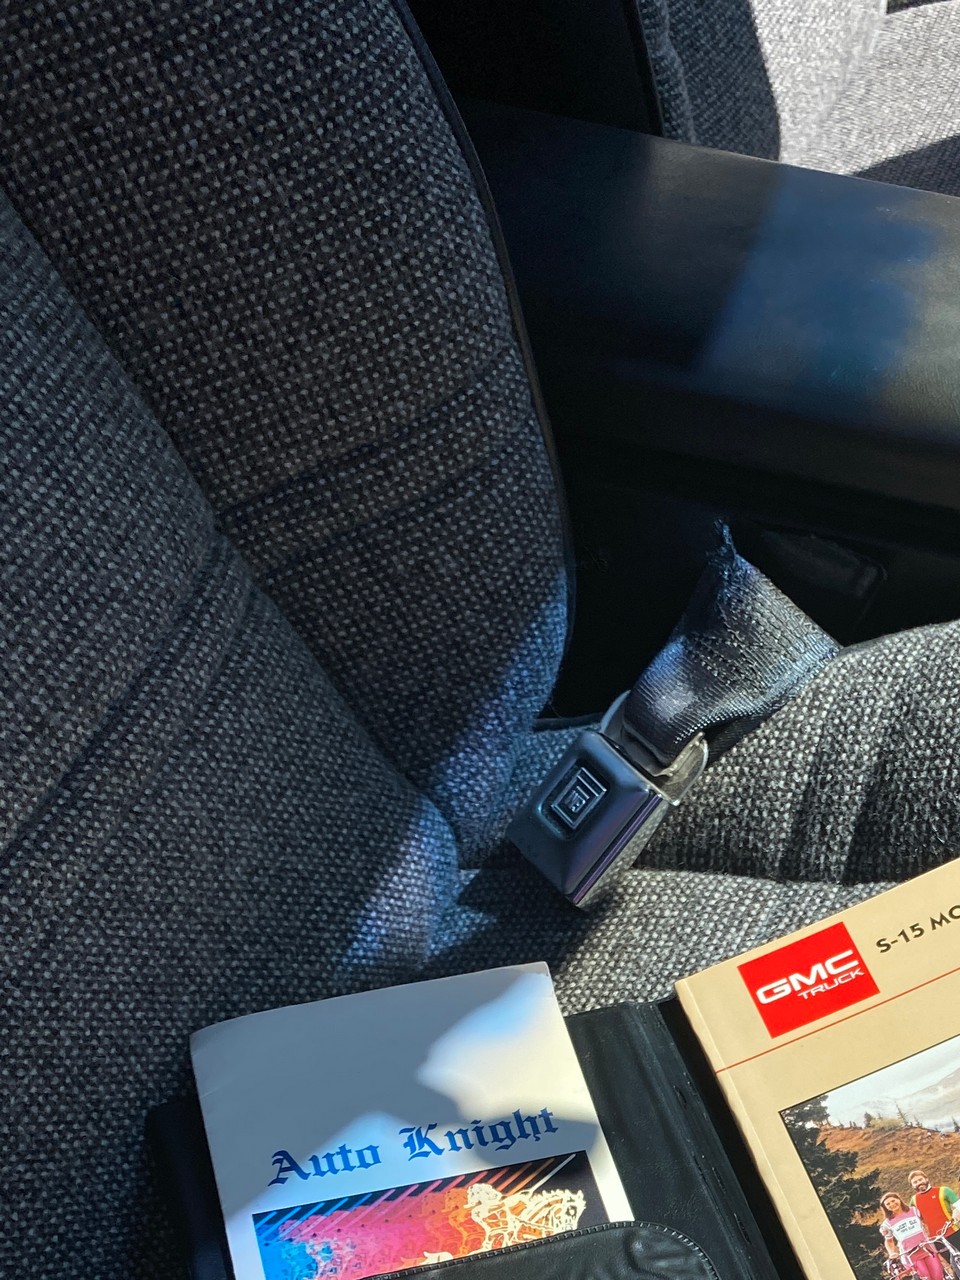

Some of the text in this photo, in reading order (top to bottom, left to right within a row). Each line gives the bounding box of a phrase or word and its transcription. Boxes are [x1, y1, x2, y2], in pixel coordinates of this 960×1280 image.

[875, 923, 925, 953] S-15
[756, 949, 860, 1005] GMC
[797, 967, 865, 1000] TRUCK
[268, 1107, 560, 1187] Auto Knight
